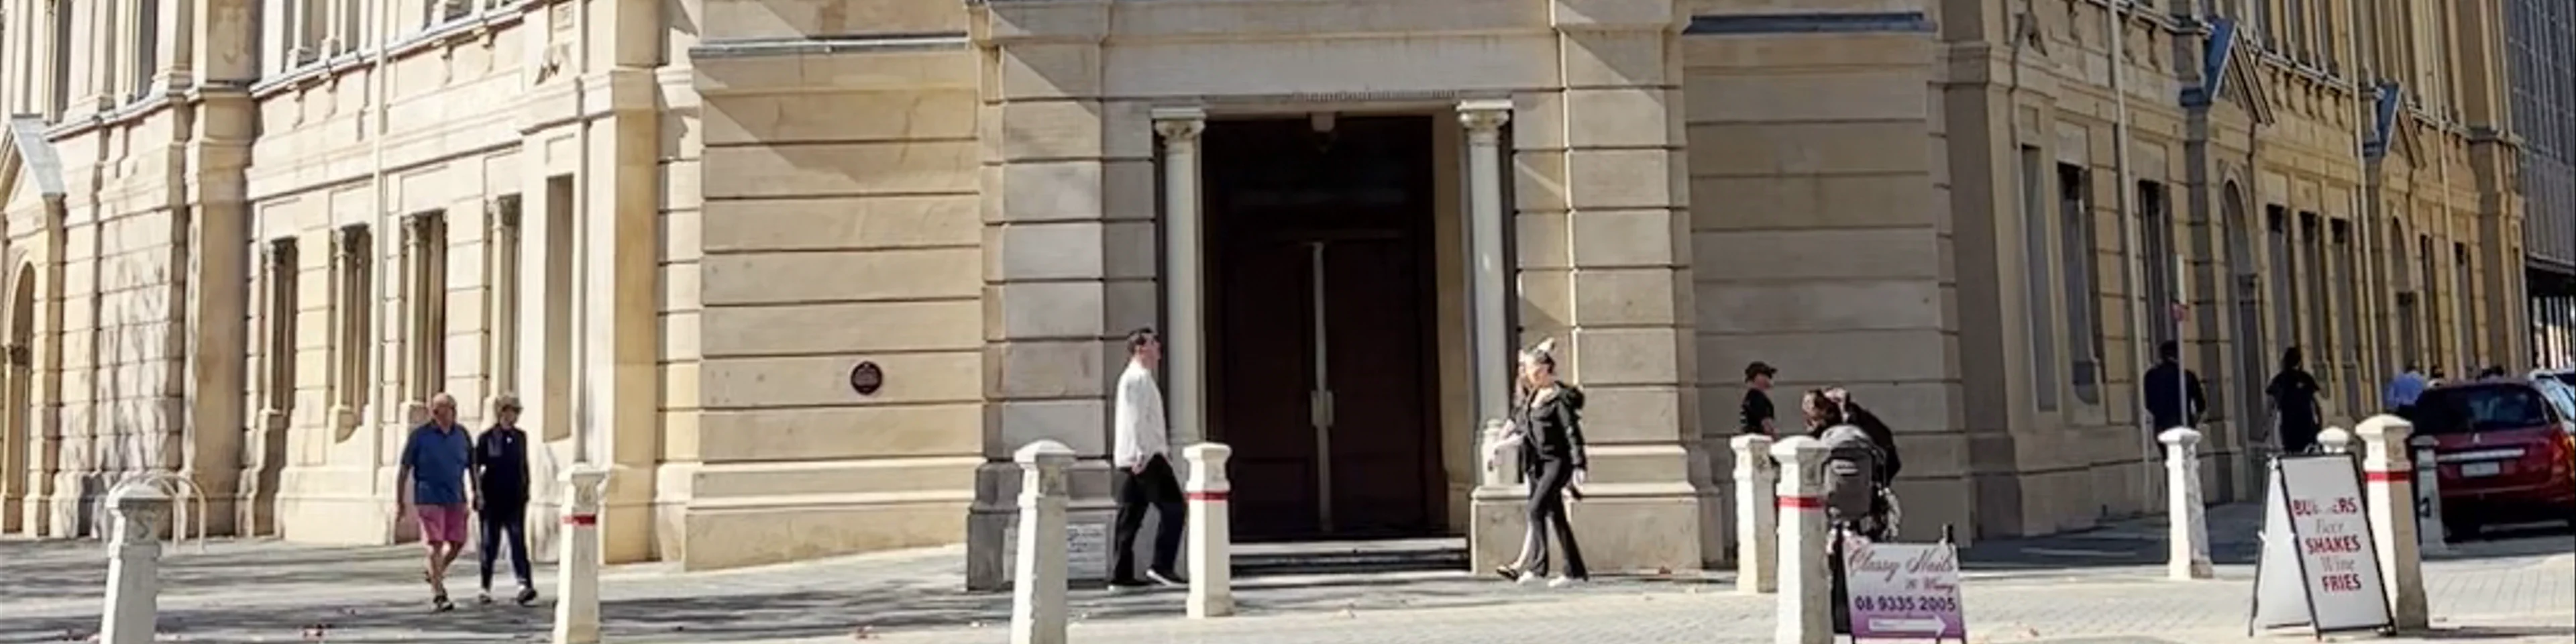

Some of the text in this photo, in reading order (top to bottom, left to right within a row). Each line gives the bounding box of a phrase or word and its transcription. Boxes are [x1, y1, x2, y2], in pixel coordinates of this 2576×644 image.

[2305, 534, 2361, 555] SHAKES
[2322, 573, 2361, 592] FRIES
[1855, 595, 1955, 612] 08 9335 2005
